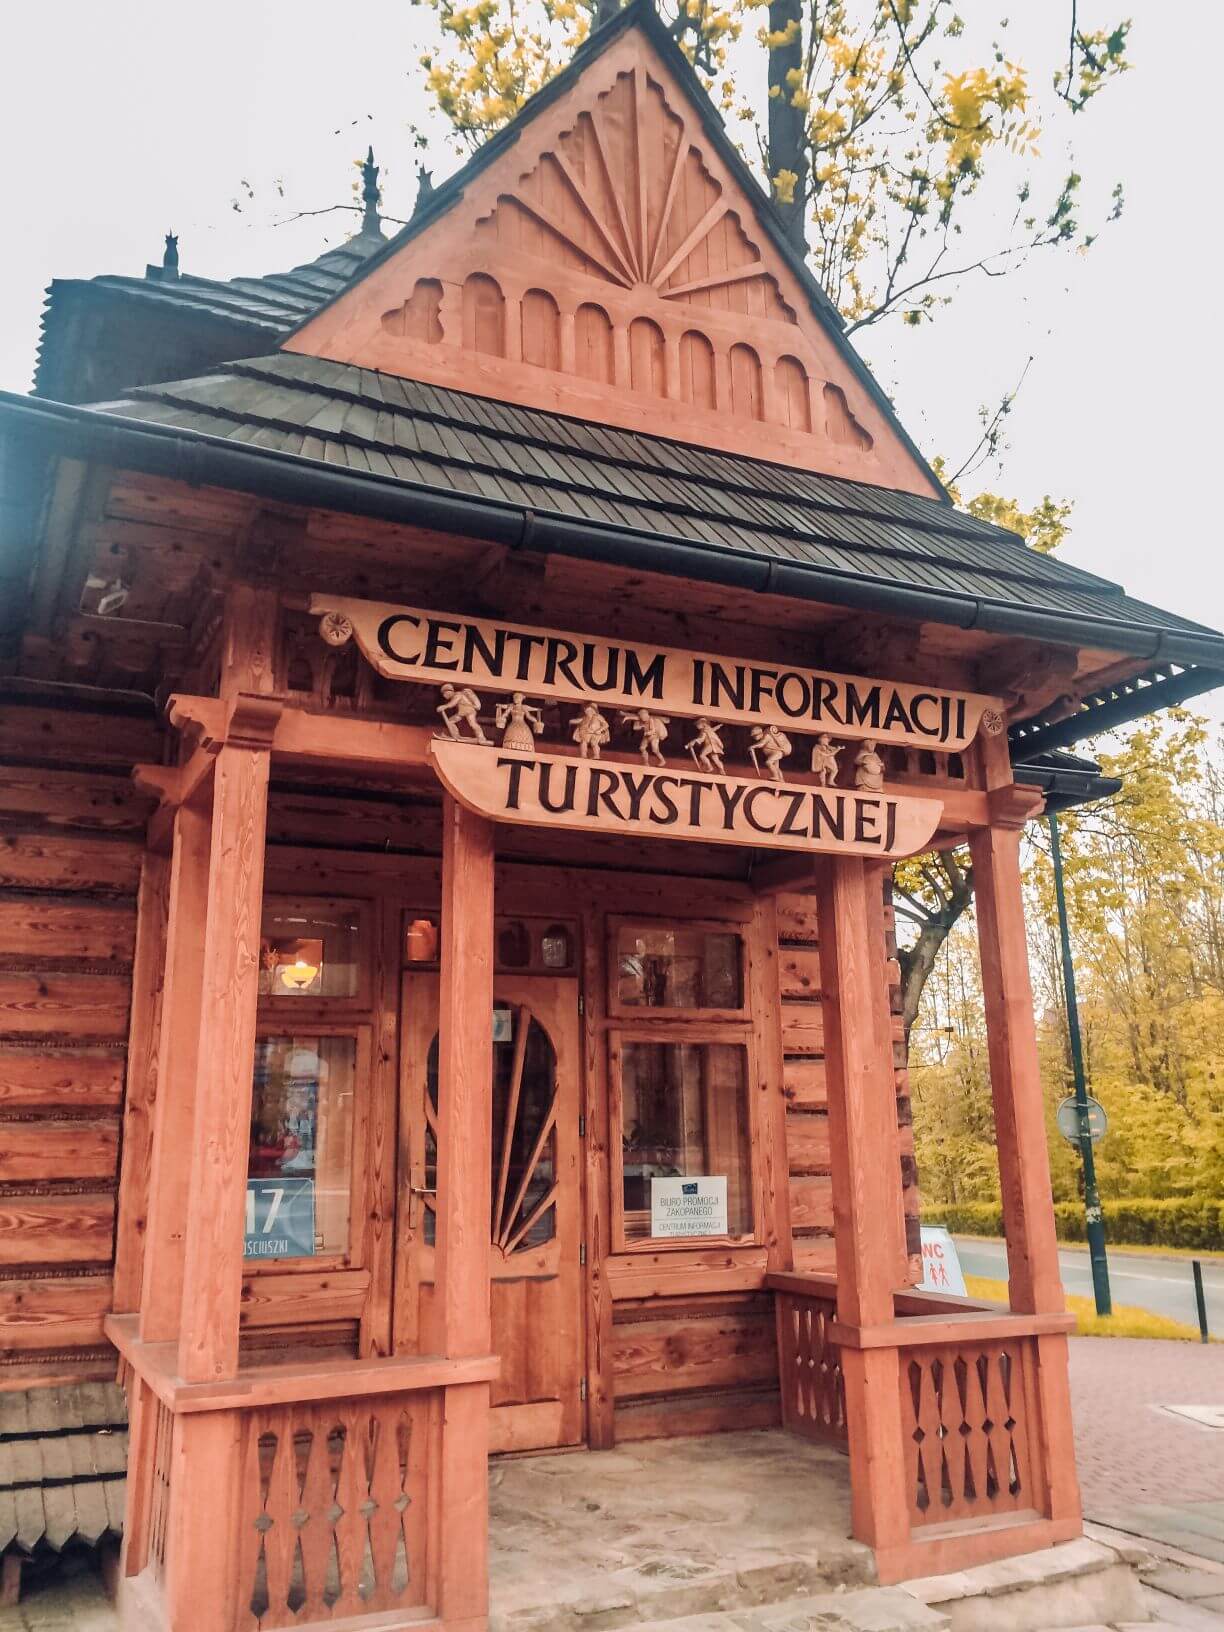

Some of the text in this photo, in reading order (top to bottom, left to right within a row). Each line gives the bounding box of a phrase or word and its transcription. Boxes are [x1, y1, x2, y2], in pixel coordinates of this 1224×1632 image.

[377, 614, 966, 743] CENTRUM INFORMACJI
[497, 758, 897, 852] TURYSTYCZNEJ
[660, 1195, 719, 1207] BIURO PROMOCJI
[666, 1206, 713, 1217] ZAKOPANEGO
[921, 1243, 944, 1259] WC
